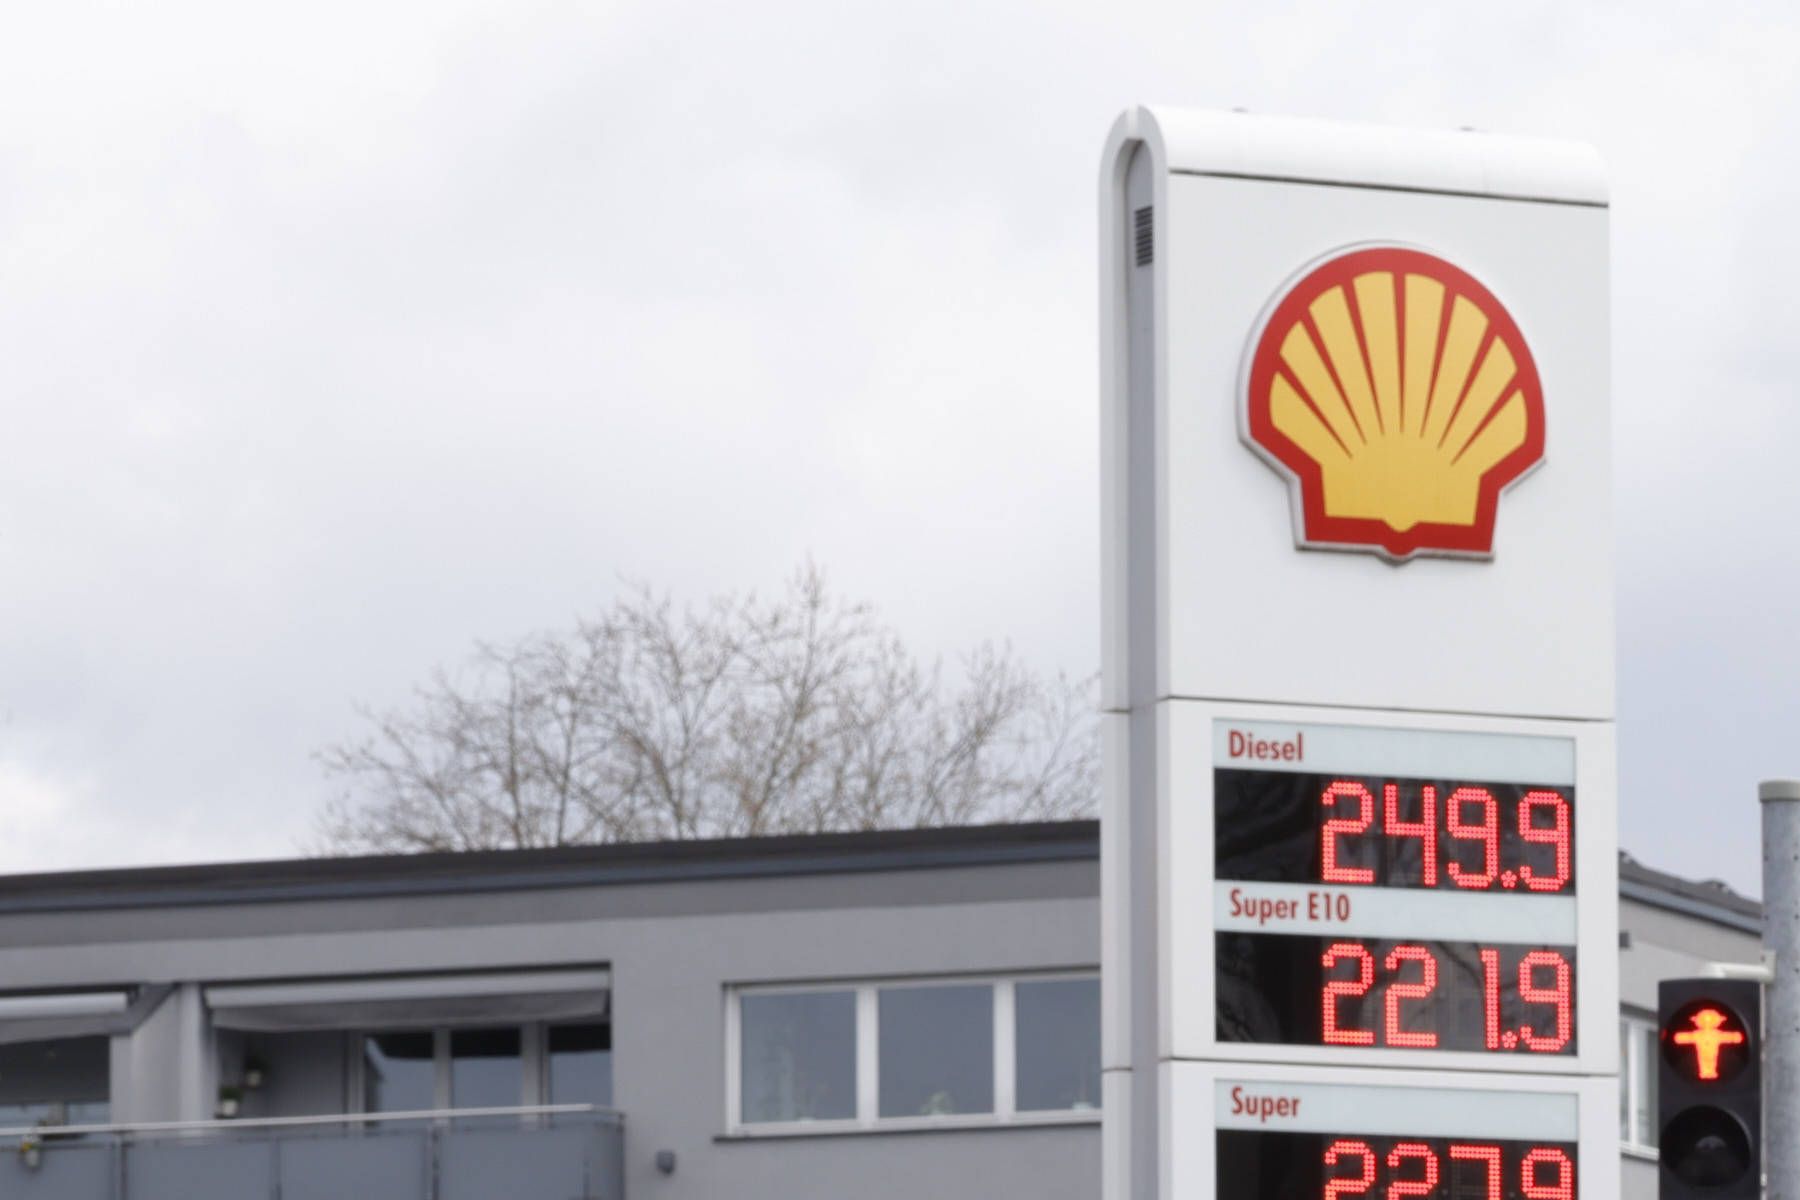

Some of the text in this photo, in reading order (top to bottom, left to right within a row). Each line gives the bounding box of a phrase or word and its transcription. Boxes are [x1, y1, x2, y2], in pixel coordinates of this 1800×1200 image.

[1228, 730, 1304, 761] Diesel
[1321, 780, 1571, 892] 249.9
[1230, 889, 1351, 924] Super E10
[1322, 942, 1572, 1051] 221.9
[1231, 1087, 1301, 1121] Super
